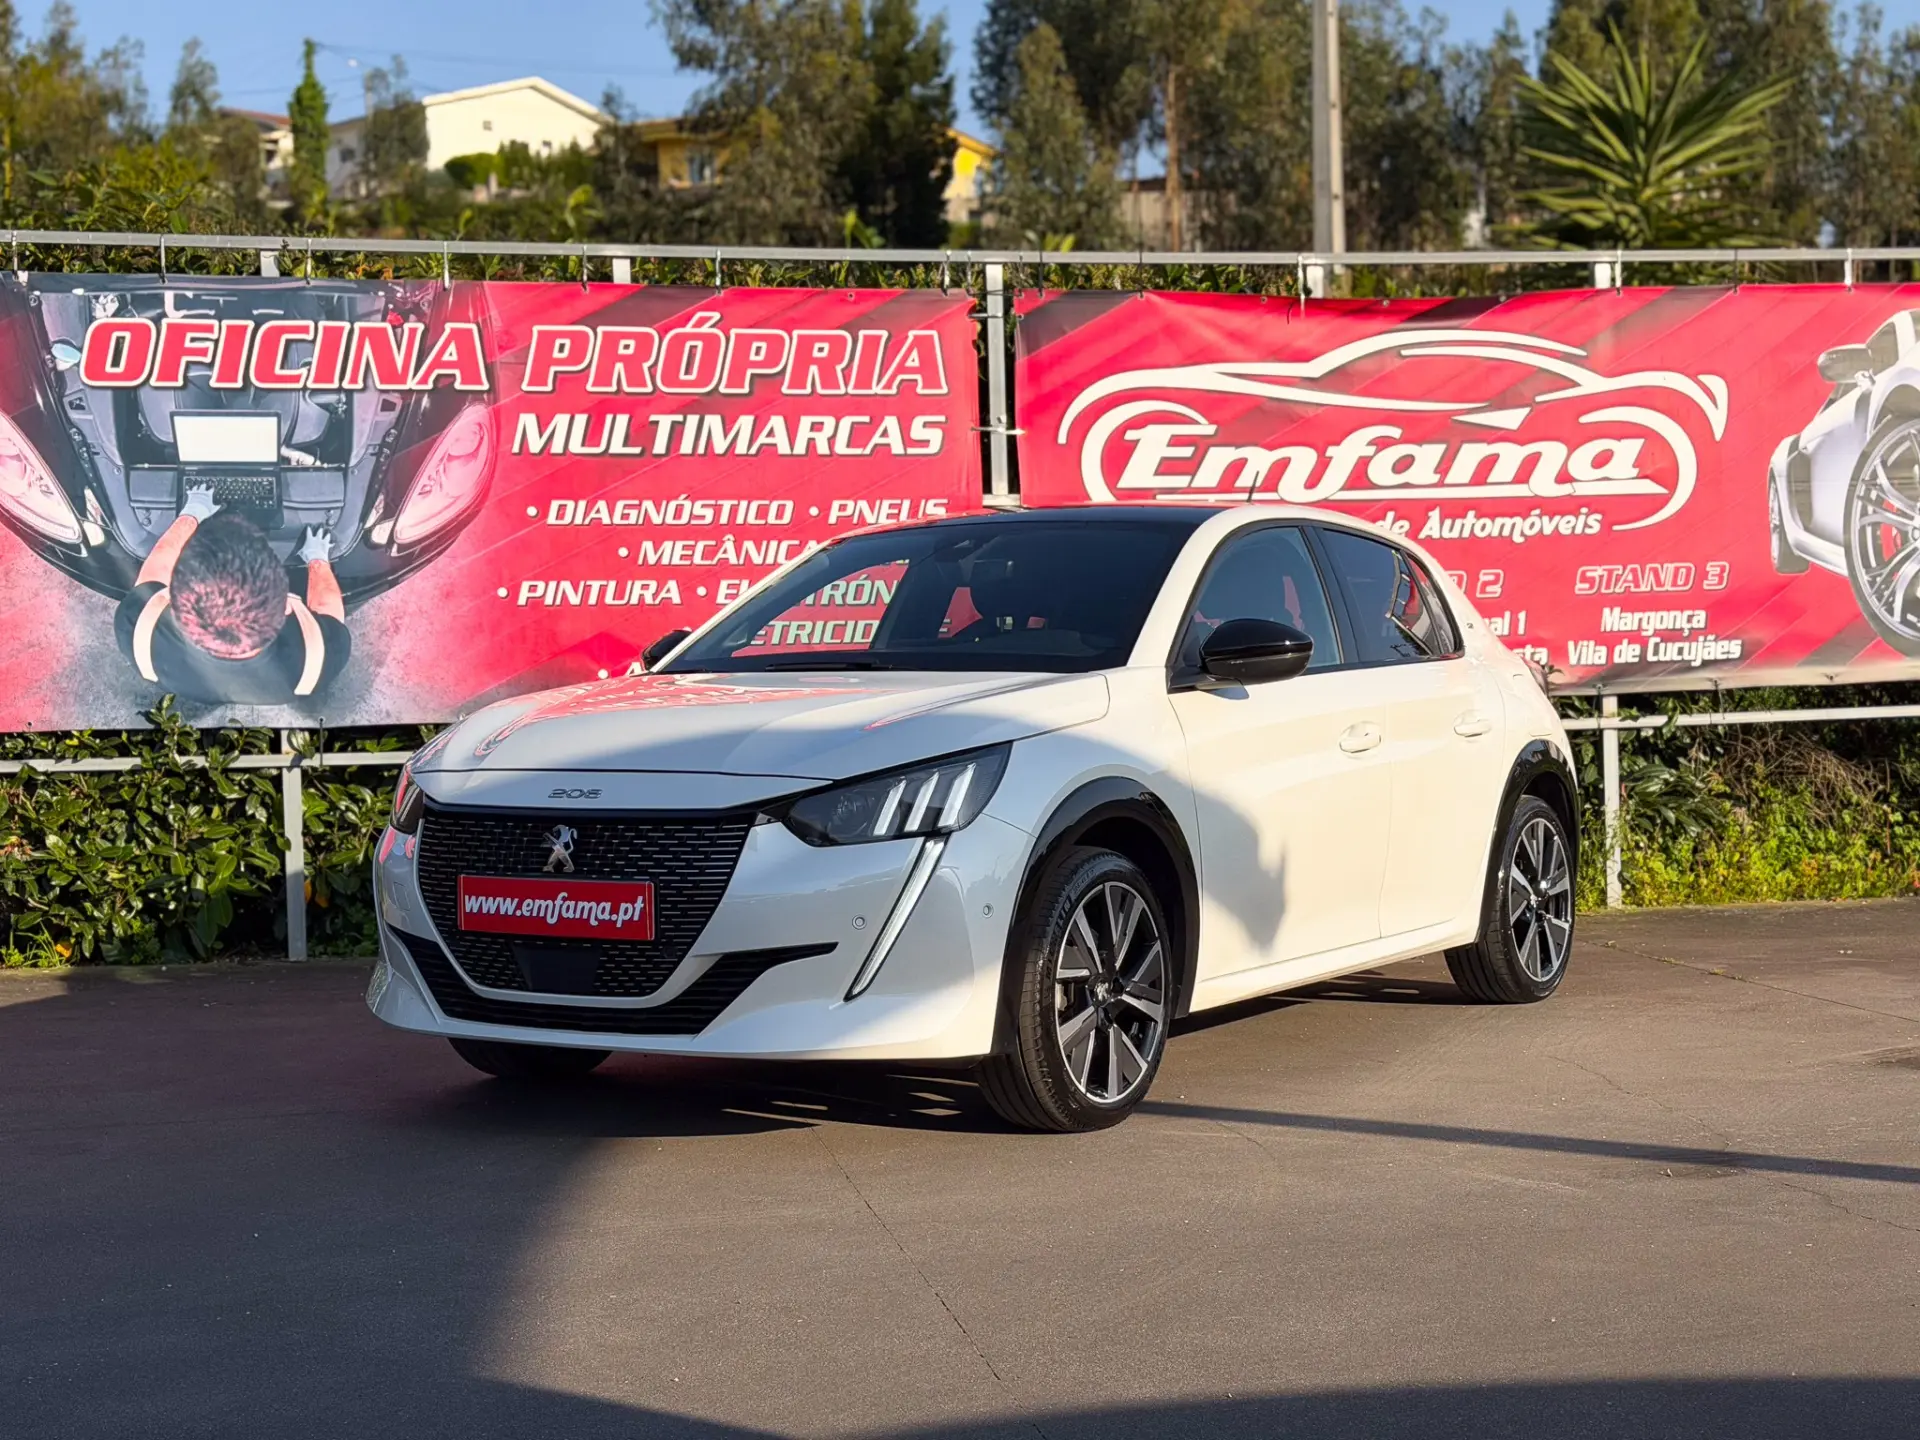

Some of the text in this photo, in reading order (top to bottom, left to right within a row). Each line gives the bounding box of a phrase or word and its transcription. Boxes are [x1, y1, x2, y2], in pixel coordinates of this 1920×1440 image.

[79, 311, 949, 395] OFICINA PRÓPRIA
[511, 412, 948, 456] MULTIMARCAS
[1117, 425, 1646, 503] Emfama
[546, 494, 949, 527] DIAGNÓSTICO PNEUS
[1418, 506, 1603, 544] Automóveis
[517, 578, 682, 605] PINTURA
[1476, 569, 1504, 598] 2
[1575, 562, 1730, 595] STAND 3
[1601, 607, 1706, 637] Margonça
[1567, 640, 1606, 666] Vila
[1613, 641, 1640, 664] de
[1646, 637, 1743, 667] Cucujães
[464, 892, 645, 928] www.emfama.pt
